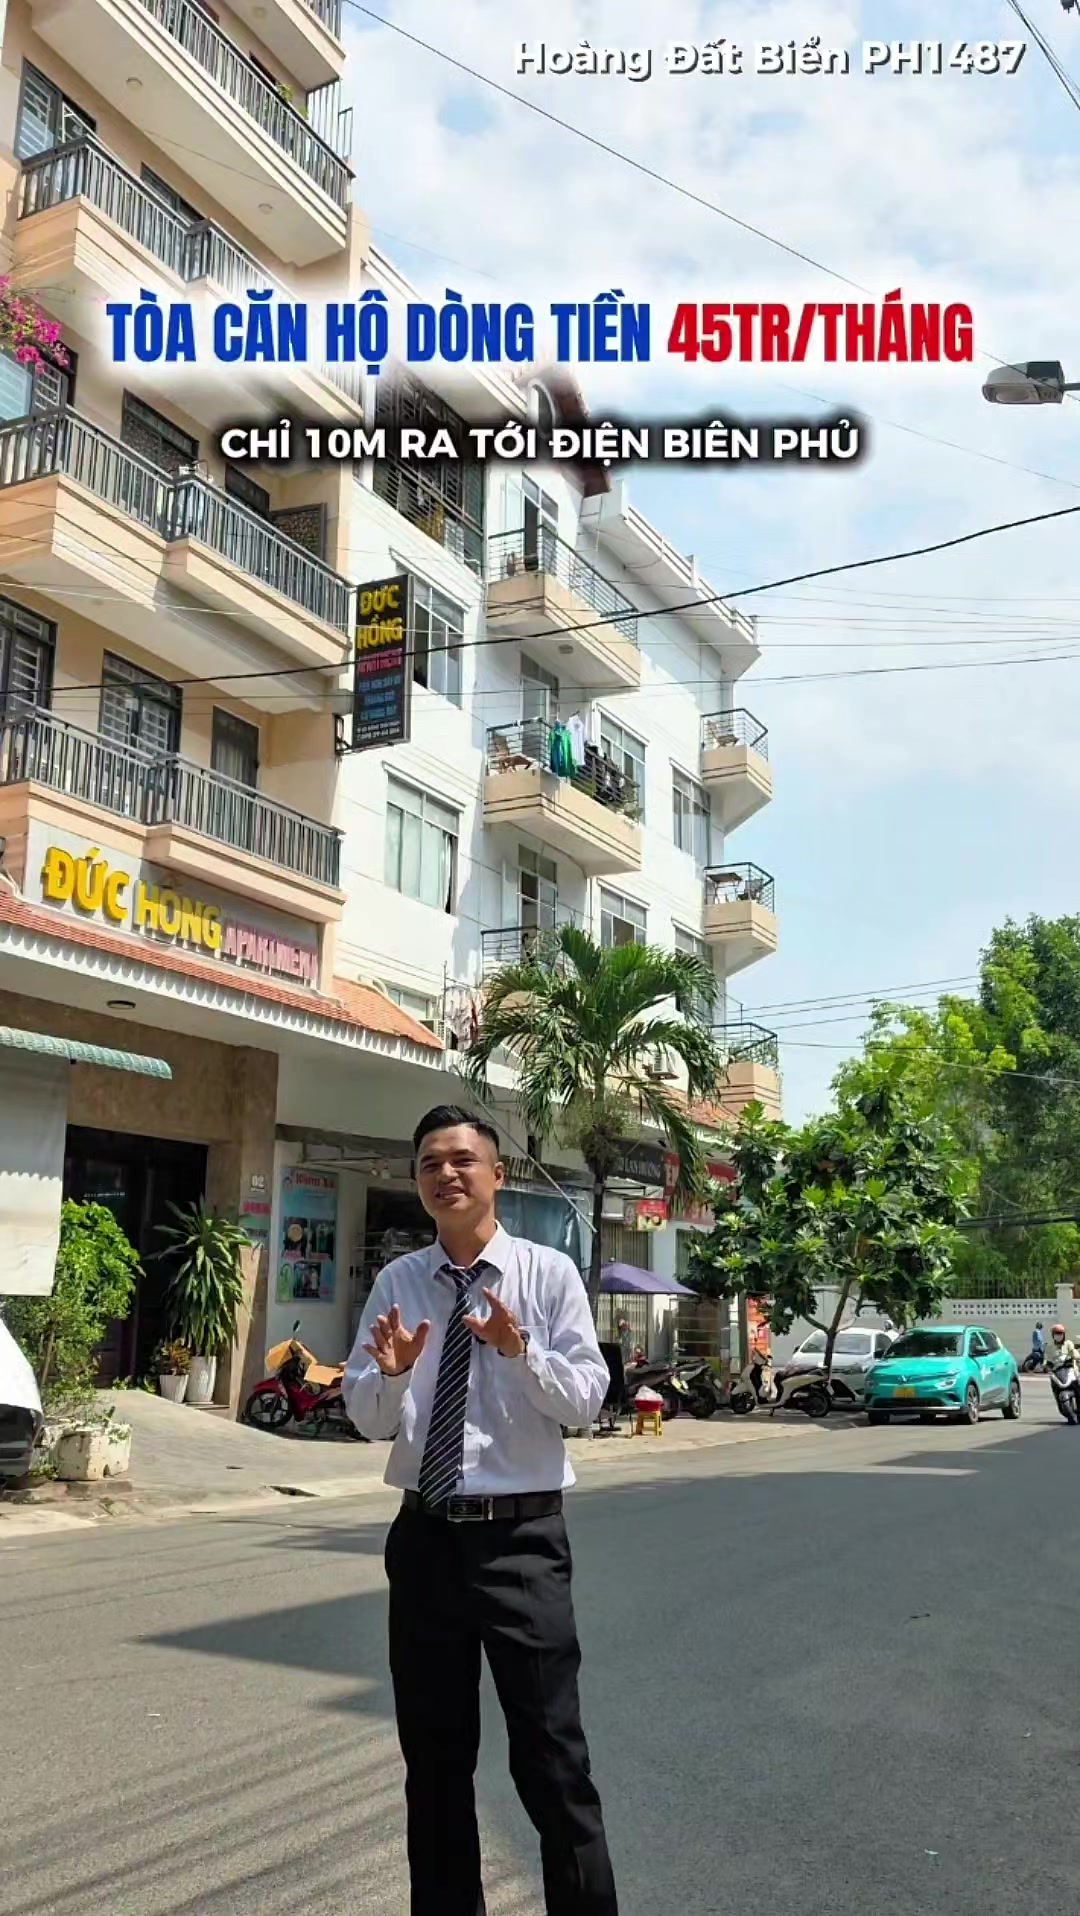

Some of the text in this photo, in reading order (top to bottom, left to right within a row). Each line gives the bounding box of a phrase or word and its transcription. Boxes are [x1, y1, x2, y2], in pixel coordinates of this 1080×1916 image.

[360, 585, 400, 615] ĐỨC
[357, 614, 403, 649] HỒNG
[41, 847, 130, 921] ĐỨC
[134, 877, 222, 952] HỒNG
